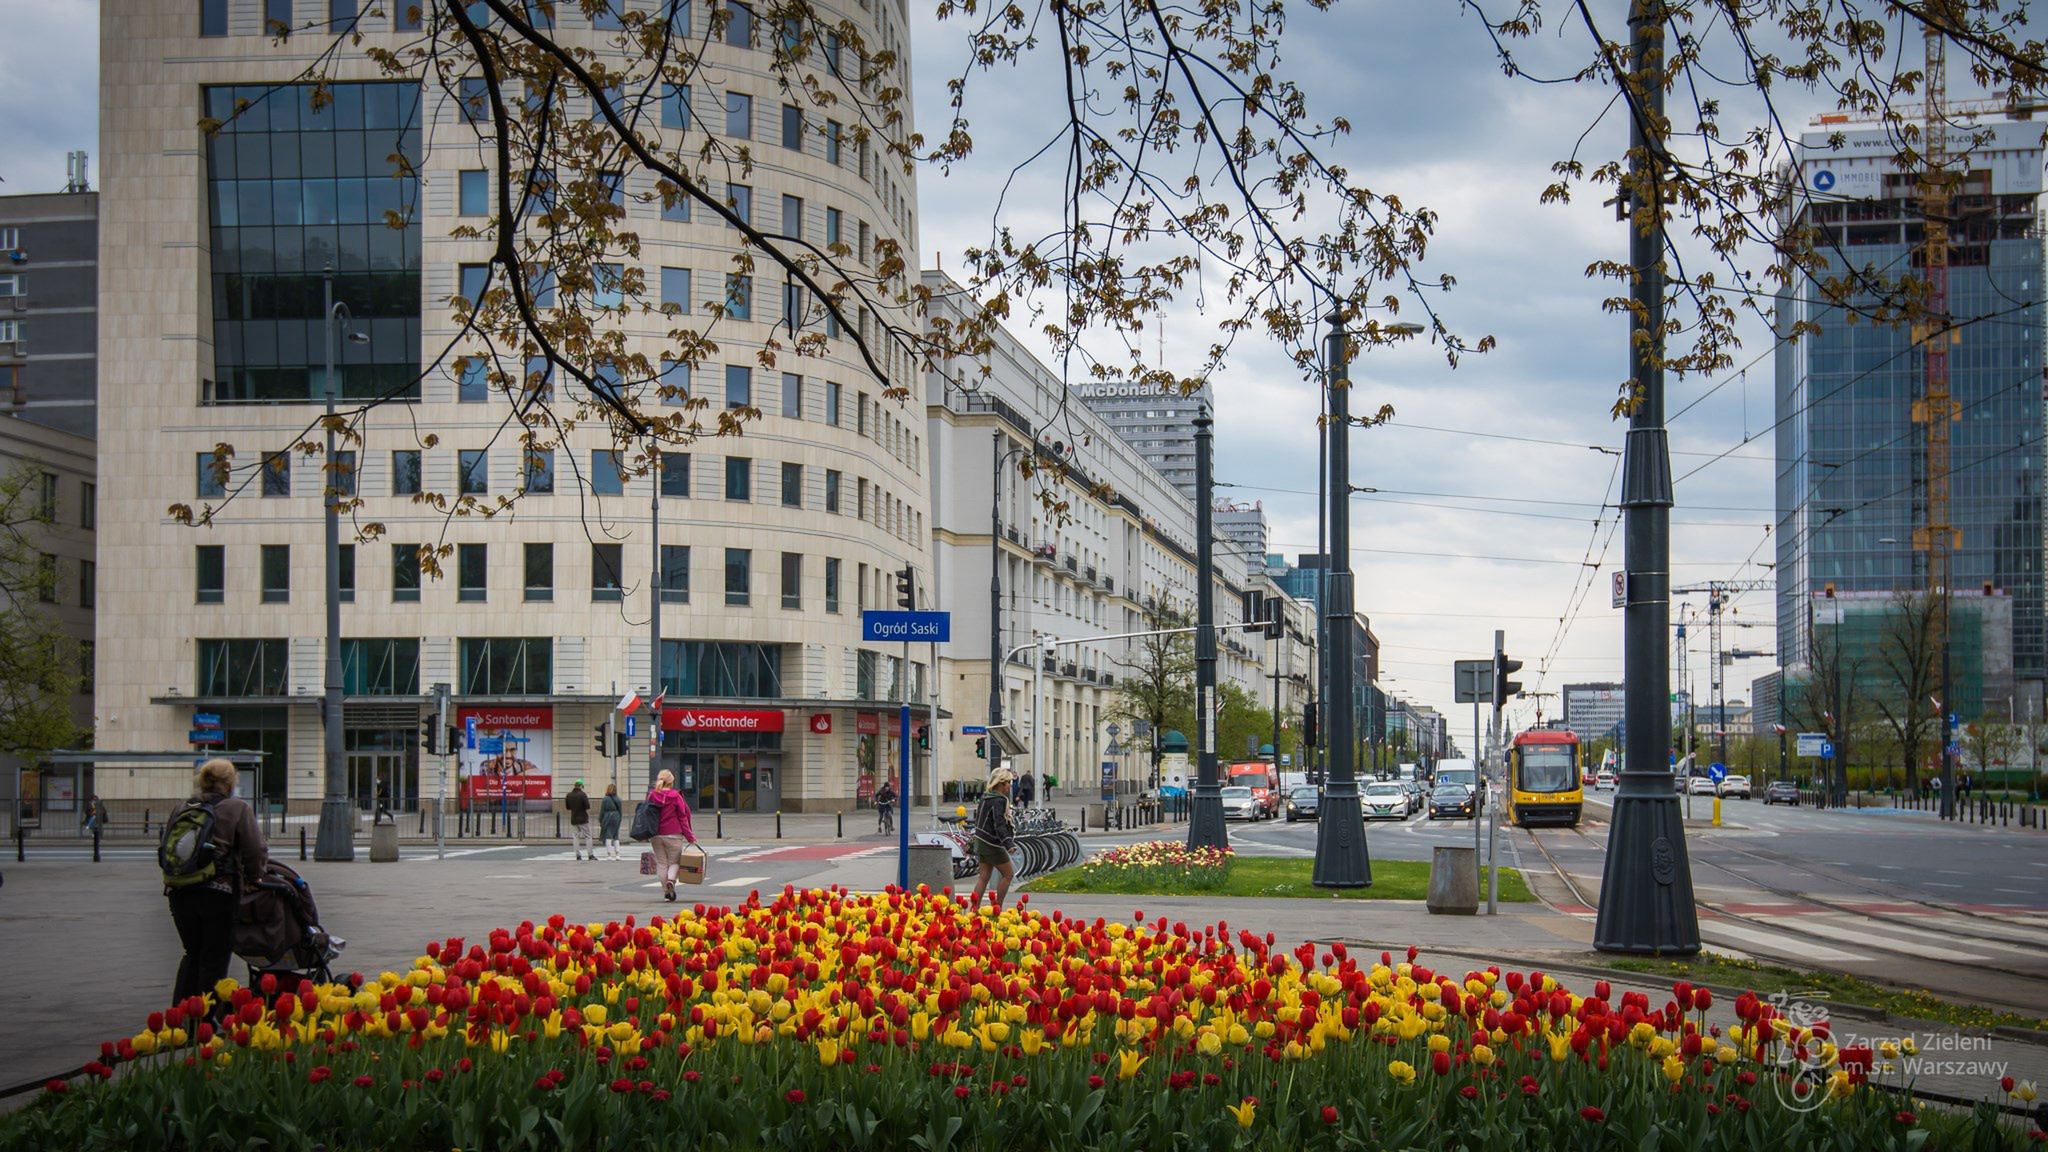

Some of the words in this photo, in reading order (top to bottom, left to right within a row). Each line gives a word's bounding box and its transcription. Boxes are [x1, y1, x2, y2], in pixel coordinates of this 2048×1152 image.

[1840, 172, 1881, 182] IMMOBEL
[1081, 385, 1178, 397] McDonalds
[873, 621, 907, 638] Ogród
[911, 622, 939, 635] Saski
[485, 714, 540, 725] Santander
[698, 715, 759, 728] Santander
[1823, 743, 1831, 753] P
